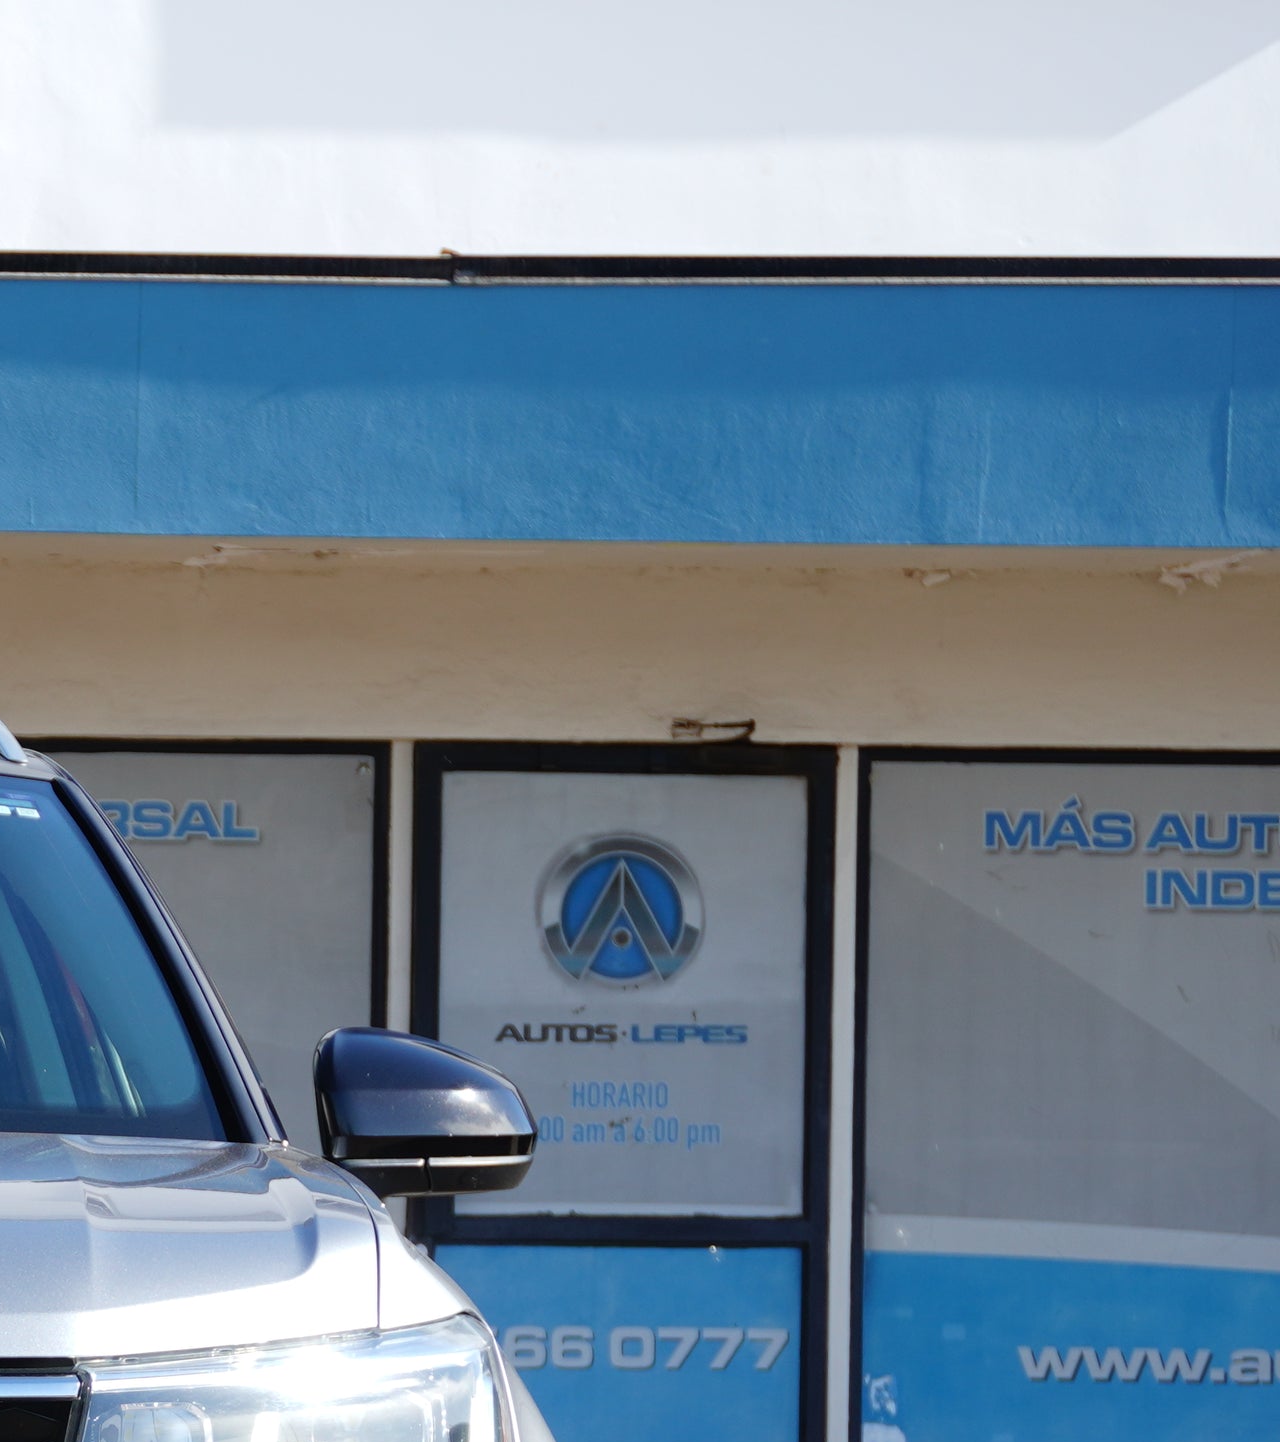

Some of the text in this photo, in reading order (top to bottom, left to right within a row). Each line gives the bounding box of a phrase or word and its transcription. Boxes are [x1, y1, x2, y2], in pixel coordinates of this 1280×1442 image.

[984, 794, 1280, 852] MÁS AUT
[571, 1081, 669, 1109] HORARIO
[572, 1122, 607, 1143] am
[632, 1116, 680, 1143] 6:00
[687, 1122, 722, 1149] pm
[491, 1325, 790, 1370] 66 0777
[1017, 1345, 1280, 1384] www.a
